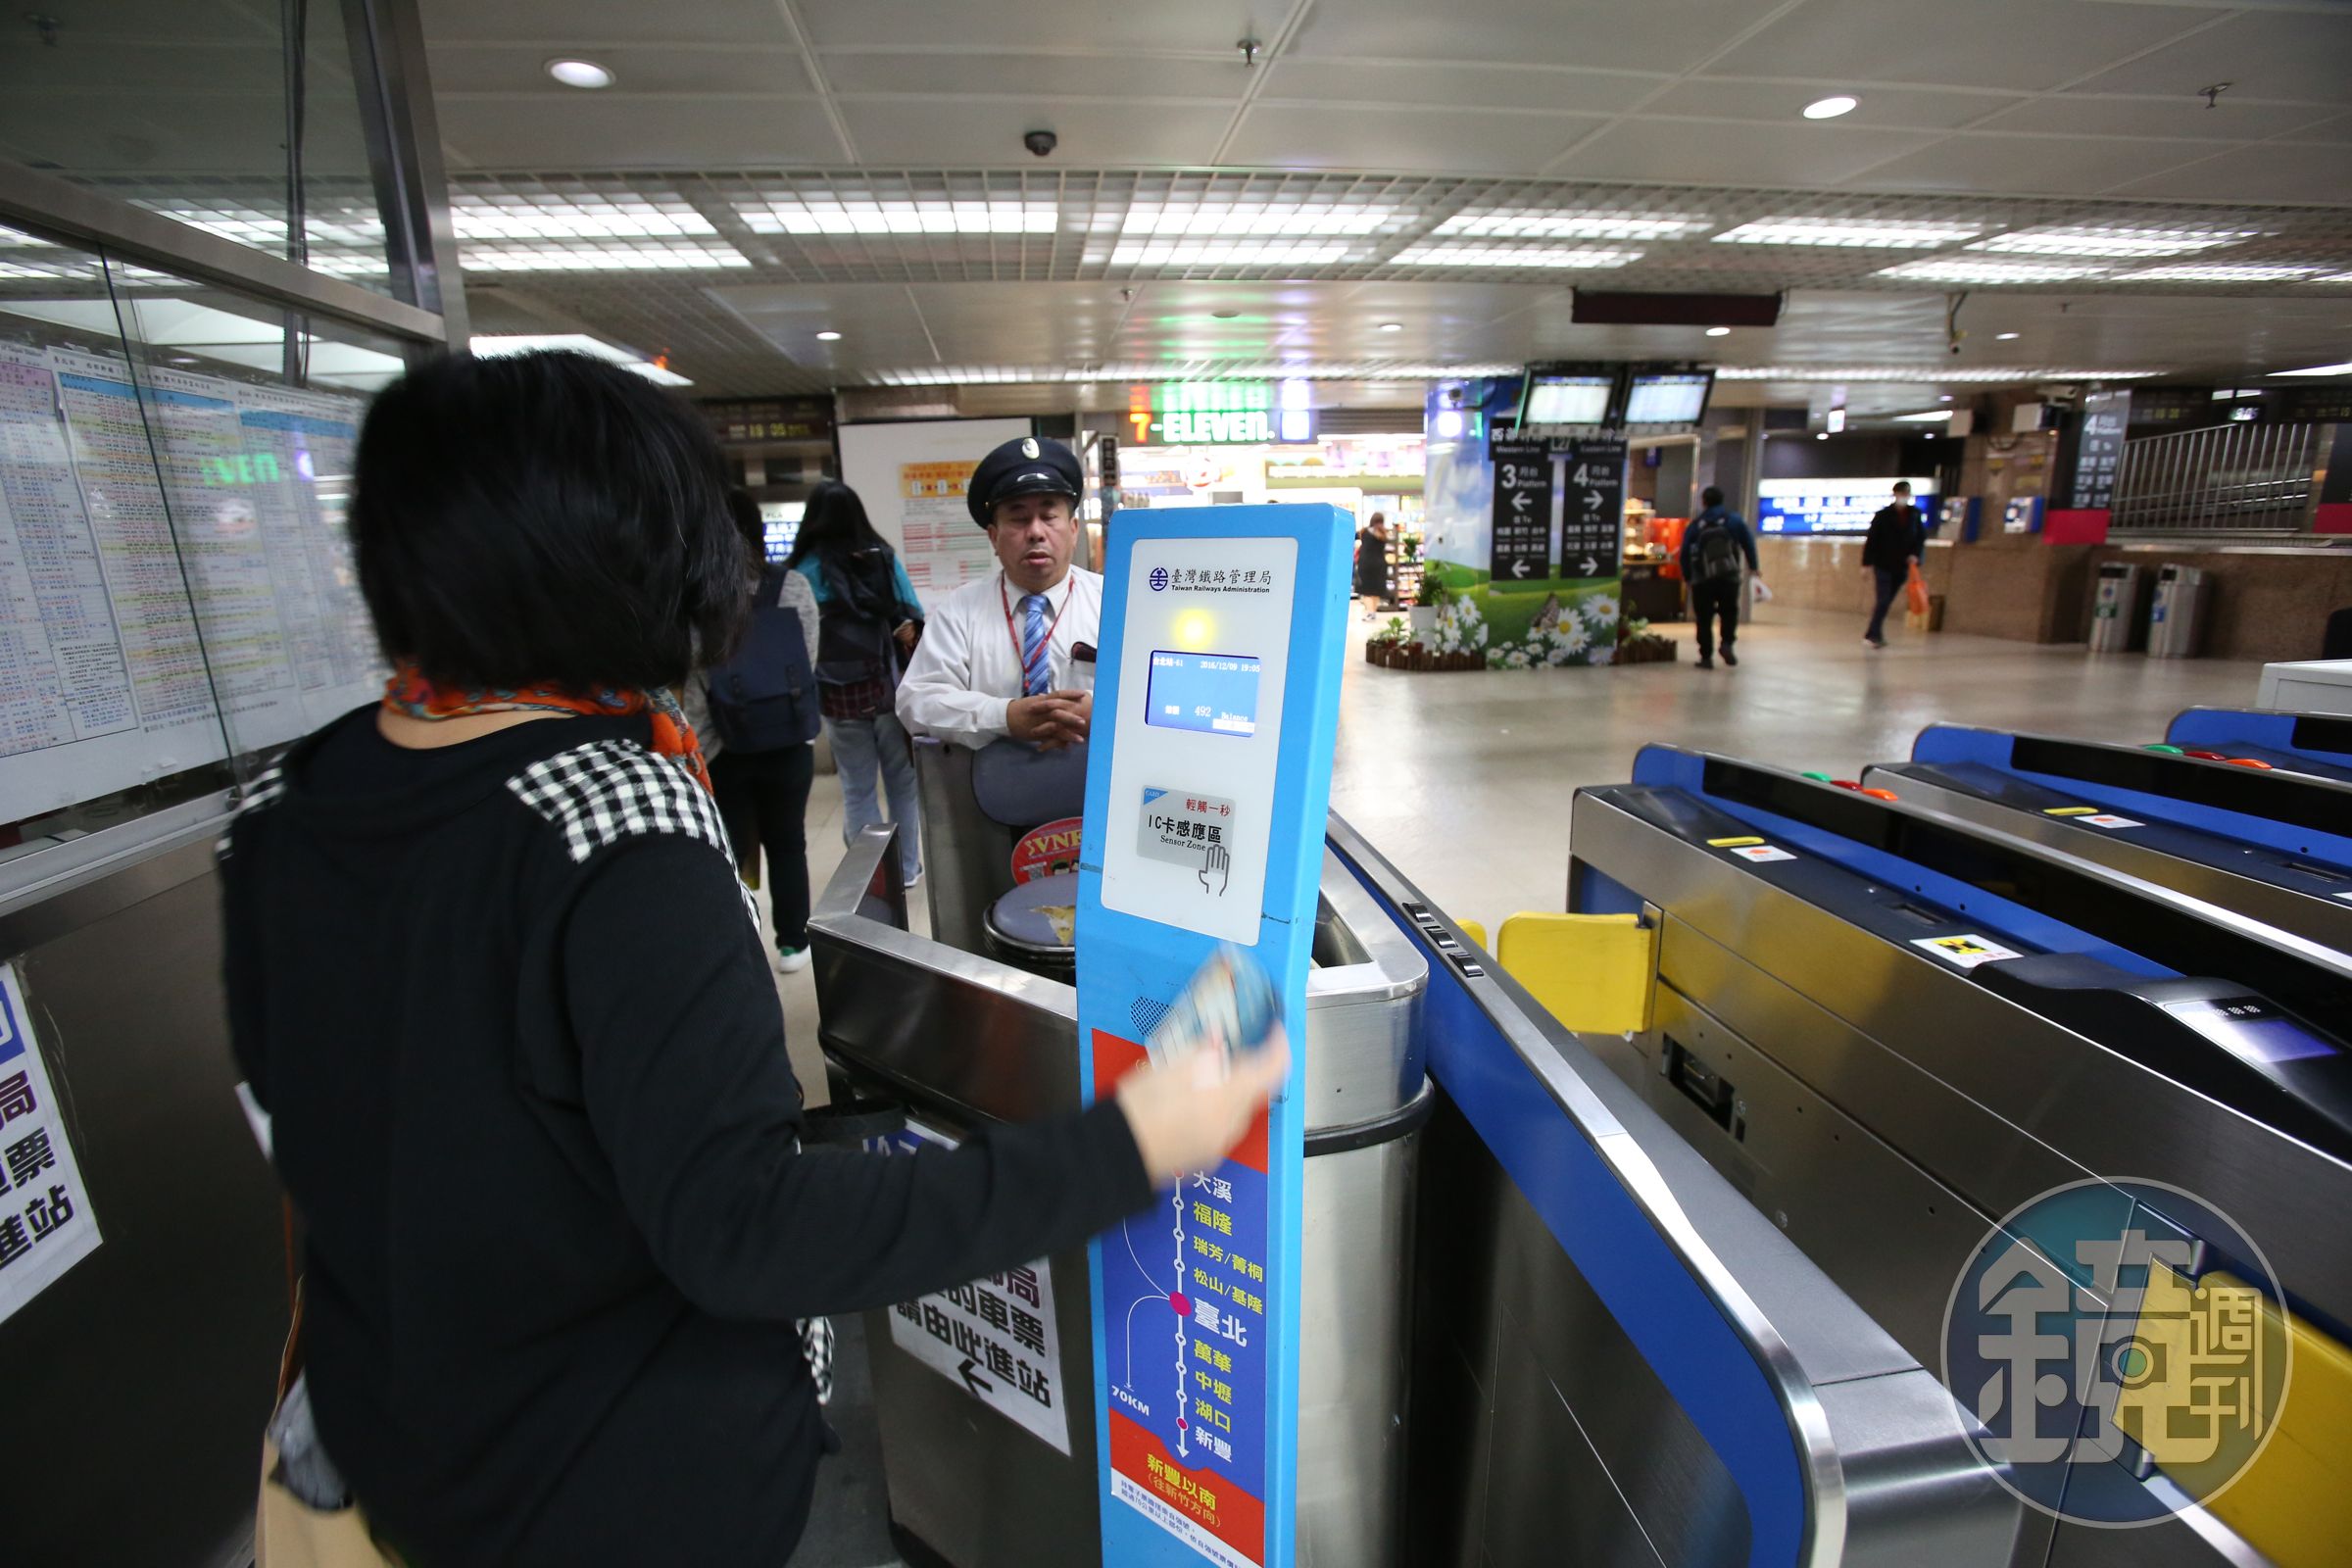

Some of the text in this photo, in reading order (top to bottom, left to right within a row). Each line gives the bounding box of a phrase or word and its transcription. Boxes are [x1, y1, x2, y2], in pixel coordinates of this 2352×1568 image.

[1501, 464, 1516, 488] 3
[1573, 463, 1589, 487] 4
[1171, 568, 1271, 585] 臺灣鐵路管理局
[1241, 663, 1260, 672] 19:05
[1194, 705, 1212, 717] 492
[1221, 711, 1249, 722] Balance
[1186, 798, 1231, 817] 輕觸一秒
[1160, 834, 1206, 852] Sensor Zone
[1193, 1170, 1232, 1203] 大溪
[1194, 1200, 1232, 1236] 福隆
[1194, 1236, 1263, 1283] 瑞芳/菁桐
[1194, 1267, 1263, 1315] 松山/基隆
[935, 1283, 1045, 1358] 的車票
[1195, 1297, 1248, 1348] 臺北
[1195, 1339, 1232, 1373] 萬華
[1111, 1385, 1150, 1417] 70KM
[1196, 1370, 1232, 1405] 中壢
[1196, 1396, 1231, 1434] 湖口
[1196, 1425, 1232, 1463] 新豐
[1147, 1452, 1216, 1510] 新豐以南
